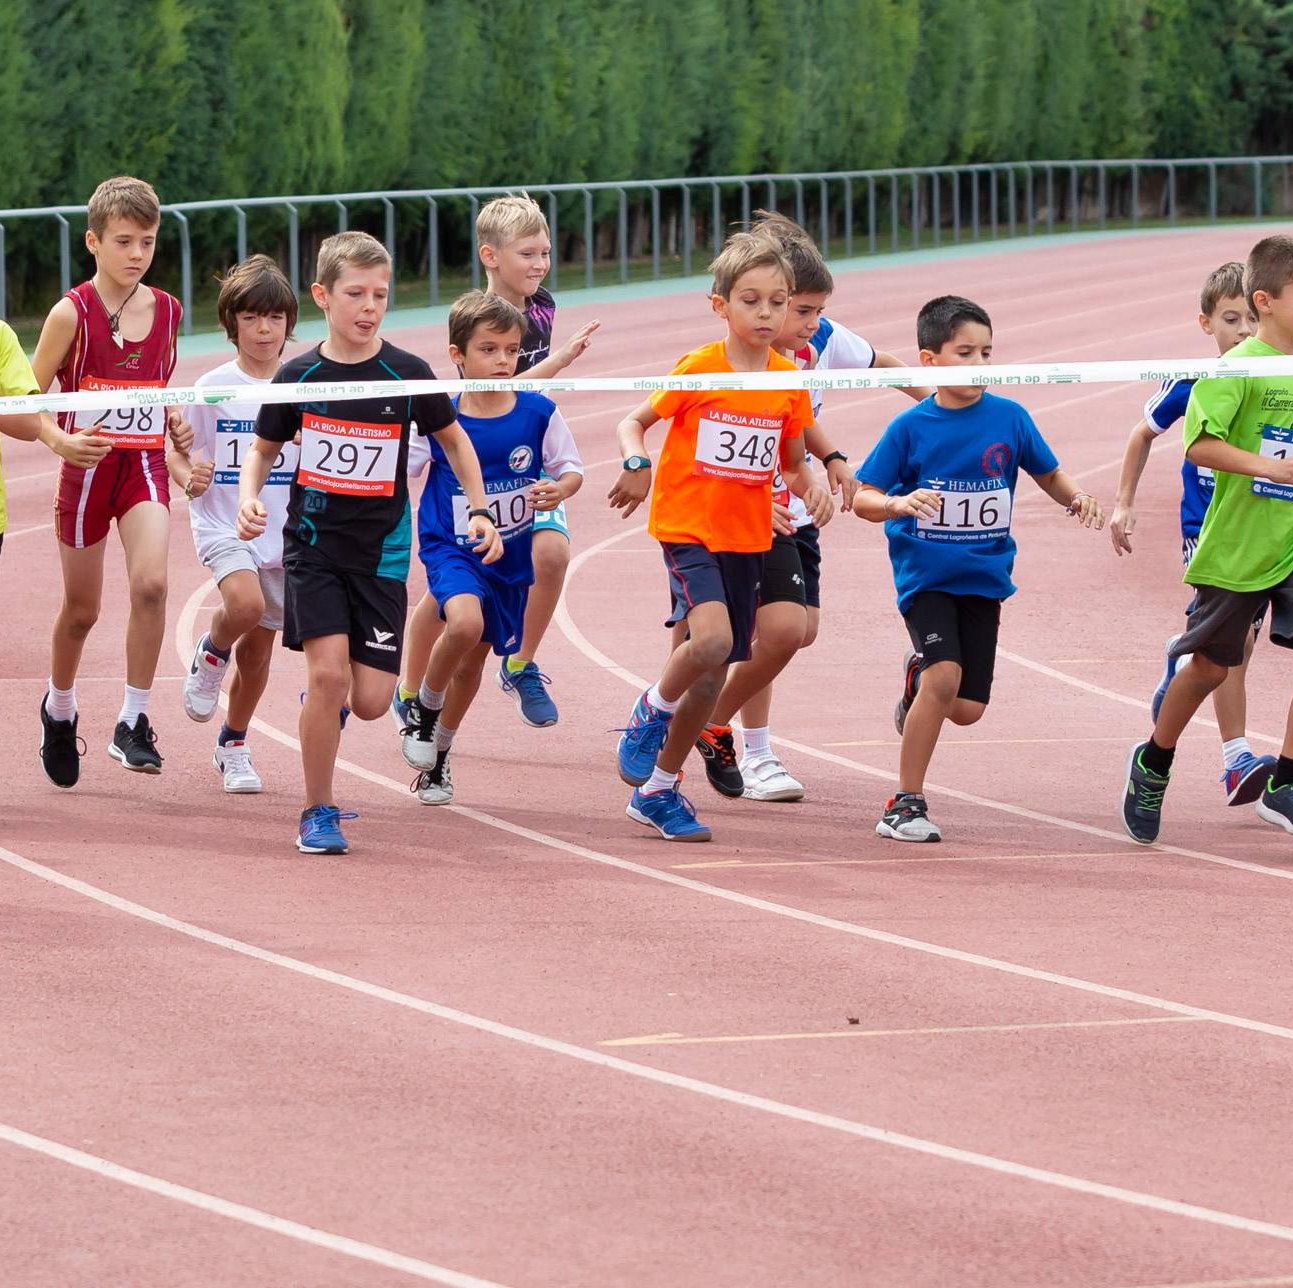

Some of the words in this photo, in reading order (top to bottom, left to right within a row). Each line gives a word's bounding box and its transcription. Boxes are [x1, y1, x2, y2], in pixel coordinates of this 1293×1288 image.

[709, 411, 720, 419] LA
[722, 414, 747, 424] RIOJA
[310, 421, 320, 429] LA
[321, 424, 346, 434] RIOJA
[349, 427, 392, 438] ATLETISMO
[715, 430, 776, 468] 348
[316, 440, 383, 478] 297
[948, 478, 1004, 491] HEMAFIX
[1263, 487, 1283, 495] Central
[932, 497, 999, 527] 116
[927, 532, 948, 540] Central
